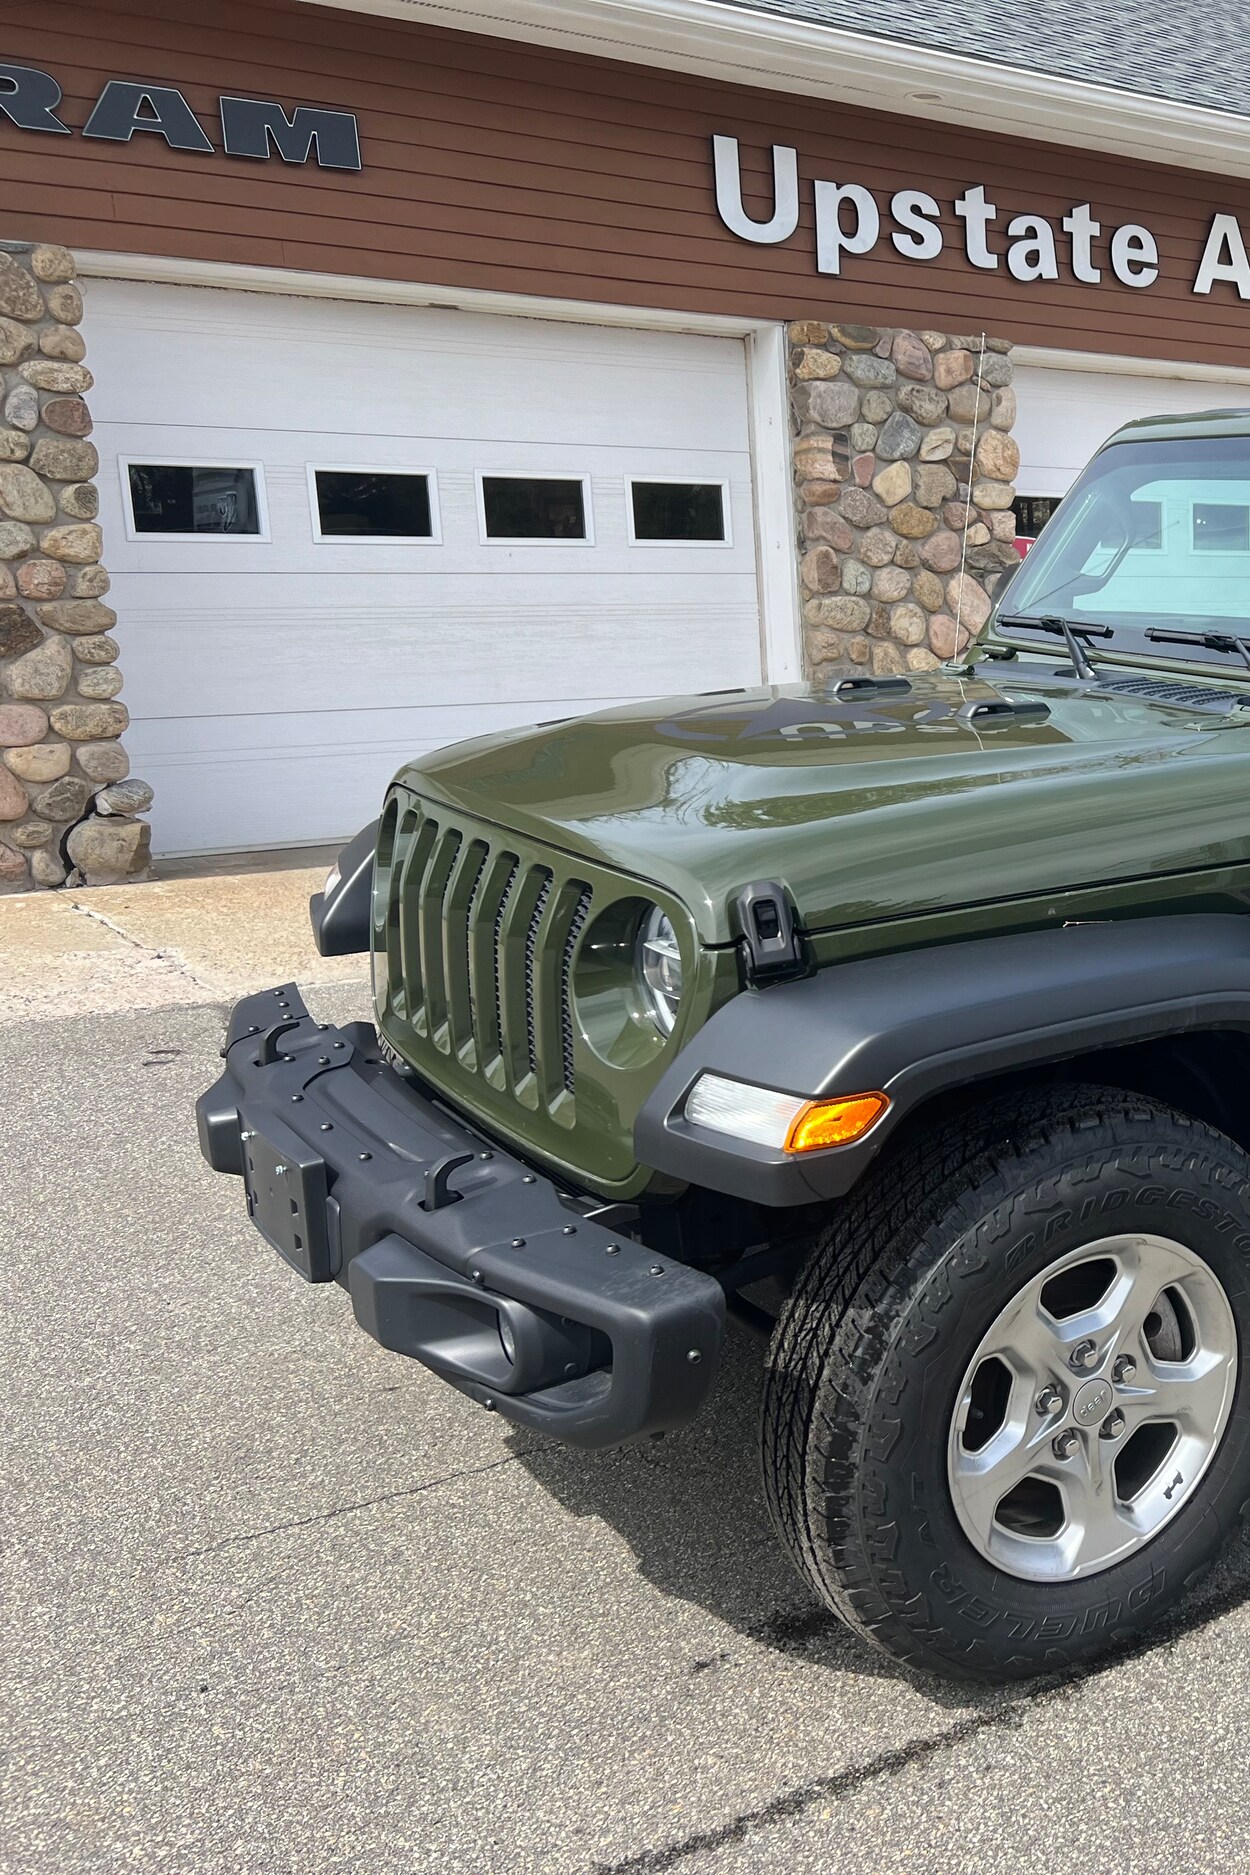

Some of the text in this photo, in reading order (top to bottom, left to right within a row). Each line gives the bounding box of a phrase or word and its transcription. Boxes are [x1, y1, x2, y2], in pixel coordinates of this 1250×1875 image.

[0, 63, 362, 171] RAM
[711, 134, 1161, 289] Upstate
[929, 1561, 1167, 1642] DUELER
